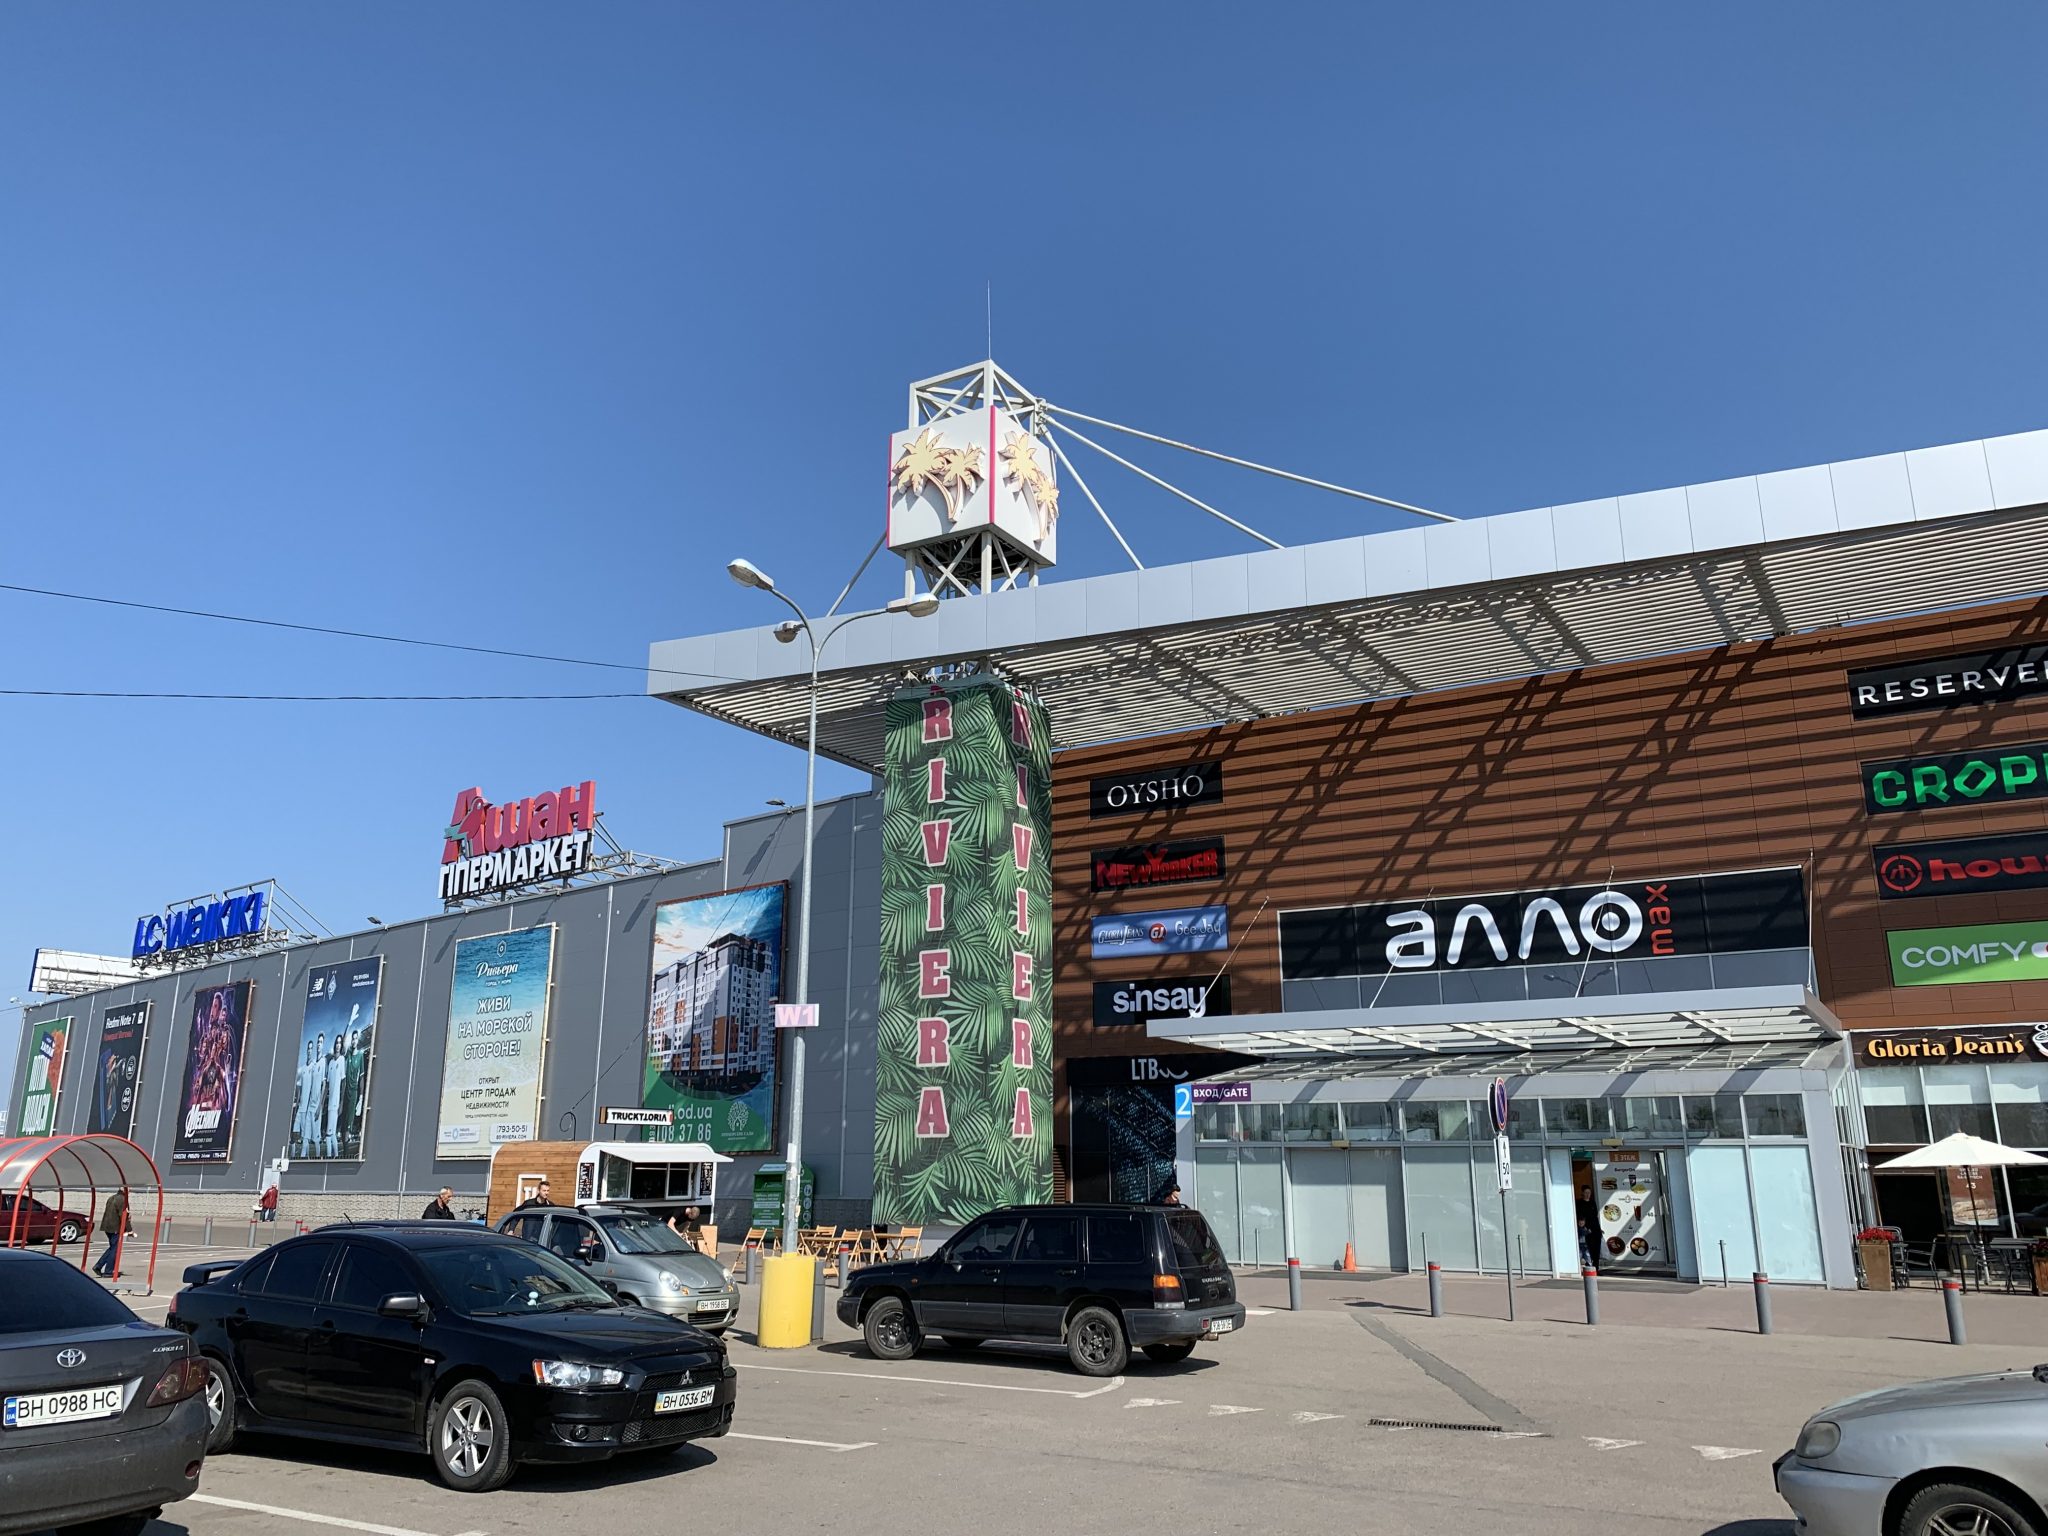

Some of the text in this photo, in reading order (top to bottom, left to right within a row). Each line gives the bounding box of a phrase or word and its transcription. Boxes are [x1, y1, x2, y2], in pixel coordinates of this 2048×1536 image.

[1857, 660, 2048, 705] RESERVE
[1107, 775, 1204, 807] OYSHO
[1872, 752, 2048, 807] CROP
[438, 832, 588, 899] ГІПЕРМАРКЕТ
[1929, 855, 2048, 882] hou
[917, 698, 953, 1137] RIVIERA
[1012, 701, 1035, 1137] RIVIERA
[1175, 918, 1222, 936] Gee Jay
[133, 915, 164, 960] LC
[1901, 941, 2027, 968] COMFY
[476, 961, 519, 978] Ривьера
[477, 996, 511, 1014] ЖИВИ
[1113, 983, 1206, 1018] sinsay
[458, 1011, 532, 1038] НА МОРСКОЙ
[778, 1009, 816, 1026] W1
[464, 1040, 521, 1060] СТОРОНЕ!
[1868, 1033, 2025, 1058] Gloria Jean's
[1131, 1058, 1159, 1080] LTB
[460, 1087, 516, 1099] ЦЕНТР ПРОДАЖ
[1176, 1088, 1191, 1115] 2
[1193, 1086, 1249, 1100] ВХОД/GATE
[466, 1101, 509, 1110] НЕДВИЖИМОСТИ
[679, 1124, 693, 1142] 37
[697, 1123, 712, 1142] 86
[1503, 1162, 1509, 1175] 50
[48, 1393, 88, 1415] 0988
[679, 1392, 699, 1407] 0536
